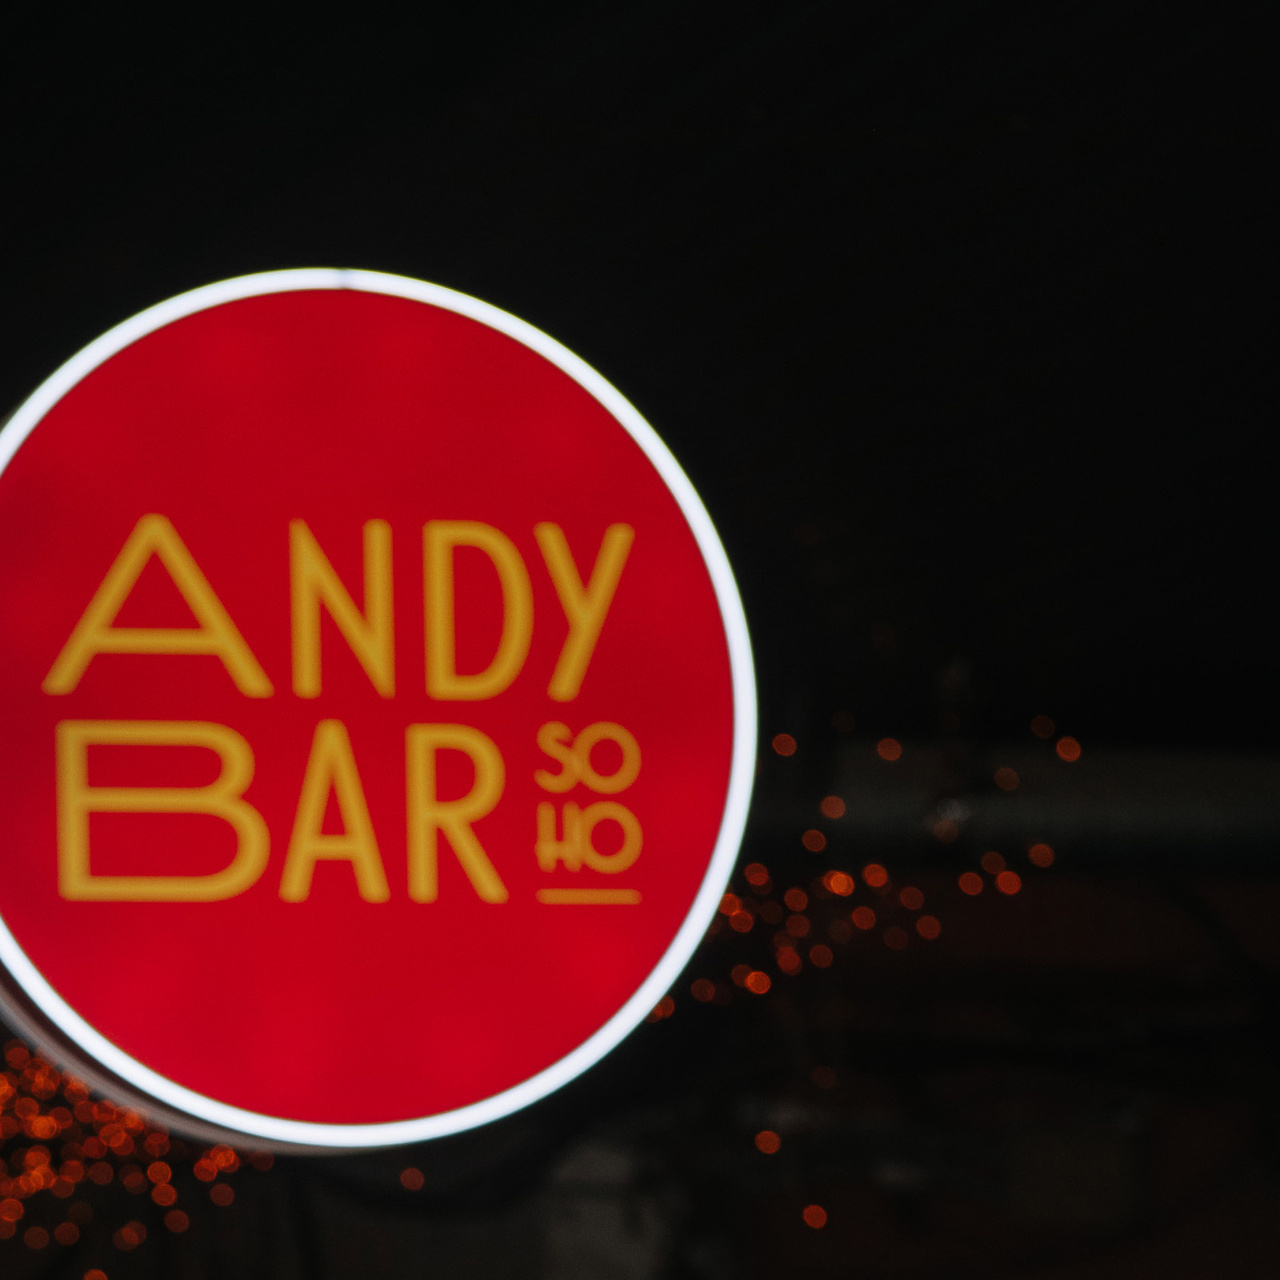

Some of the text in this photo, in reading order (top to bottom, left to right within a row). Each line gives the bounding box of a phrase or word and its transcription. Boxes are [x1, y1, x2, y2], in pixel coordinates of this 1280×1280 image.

[41, 512, 636, 702] ANDY
[55, 717, 510, 905] BAR
[533, 721, 642, 794] SO
[533, 800, 644, 875] HO
